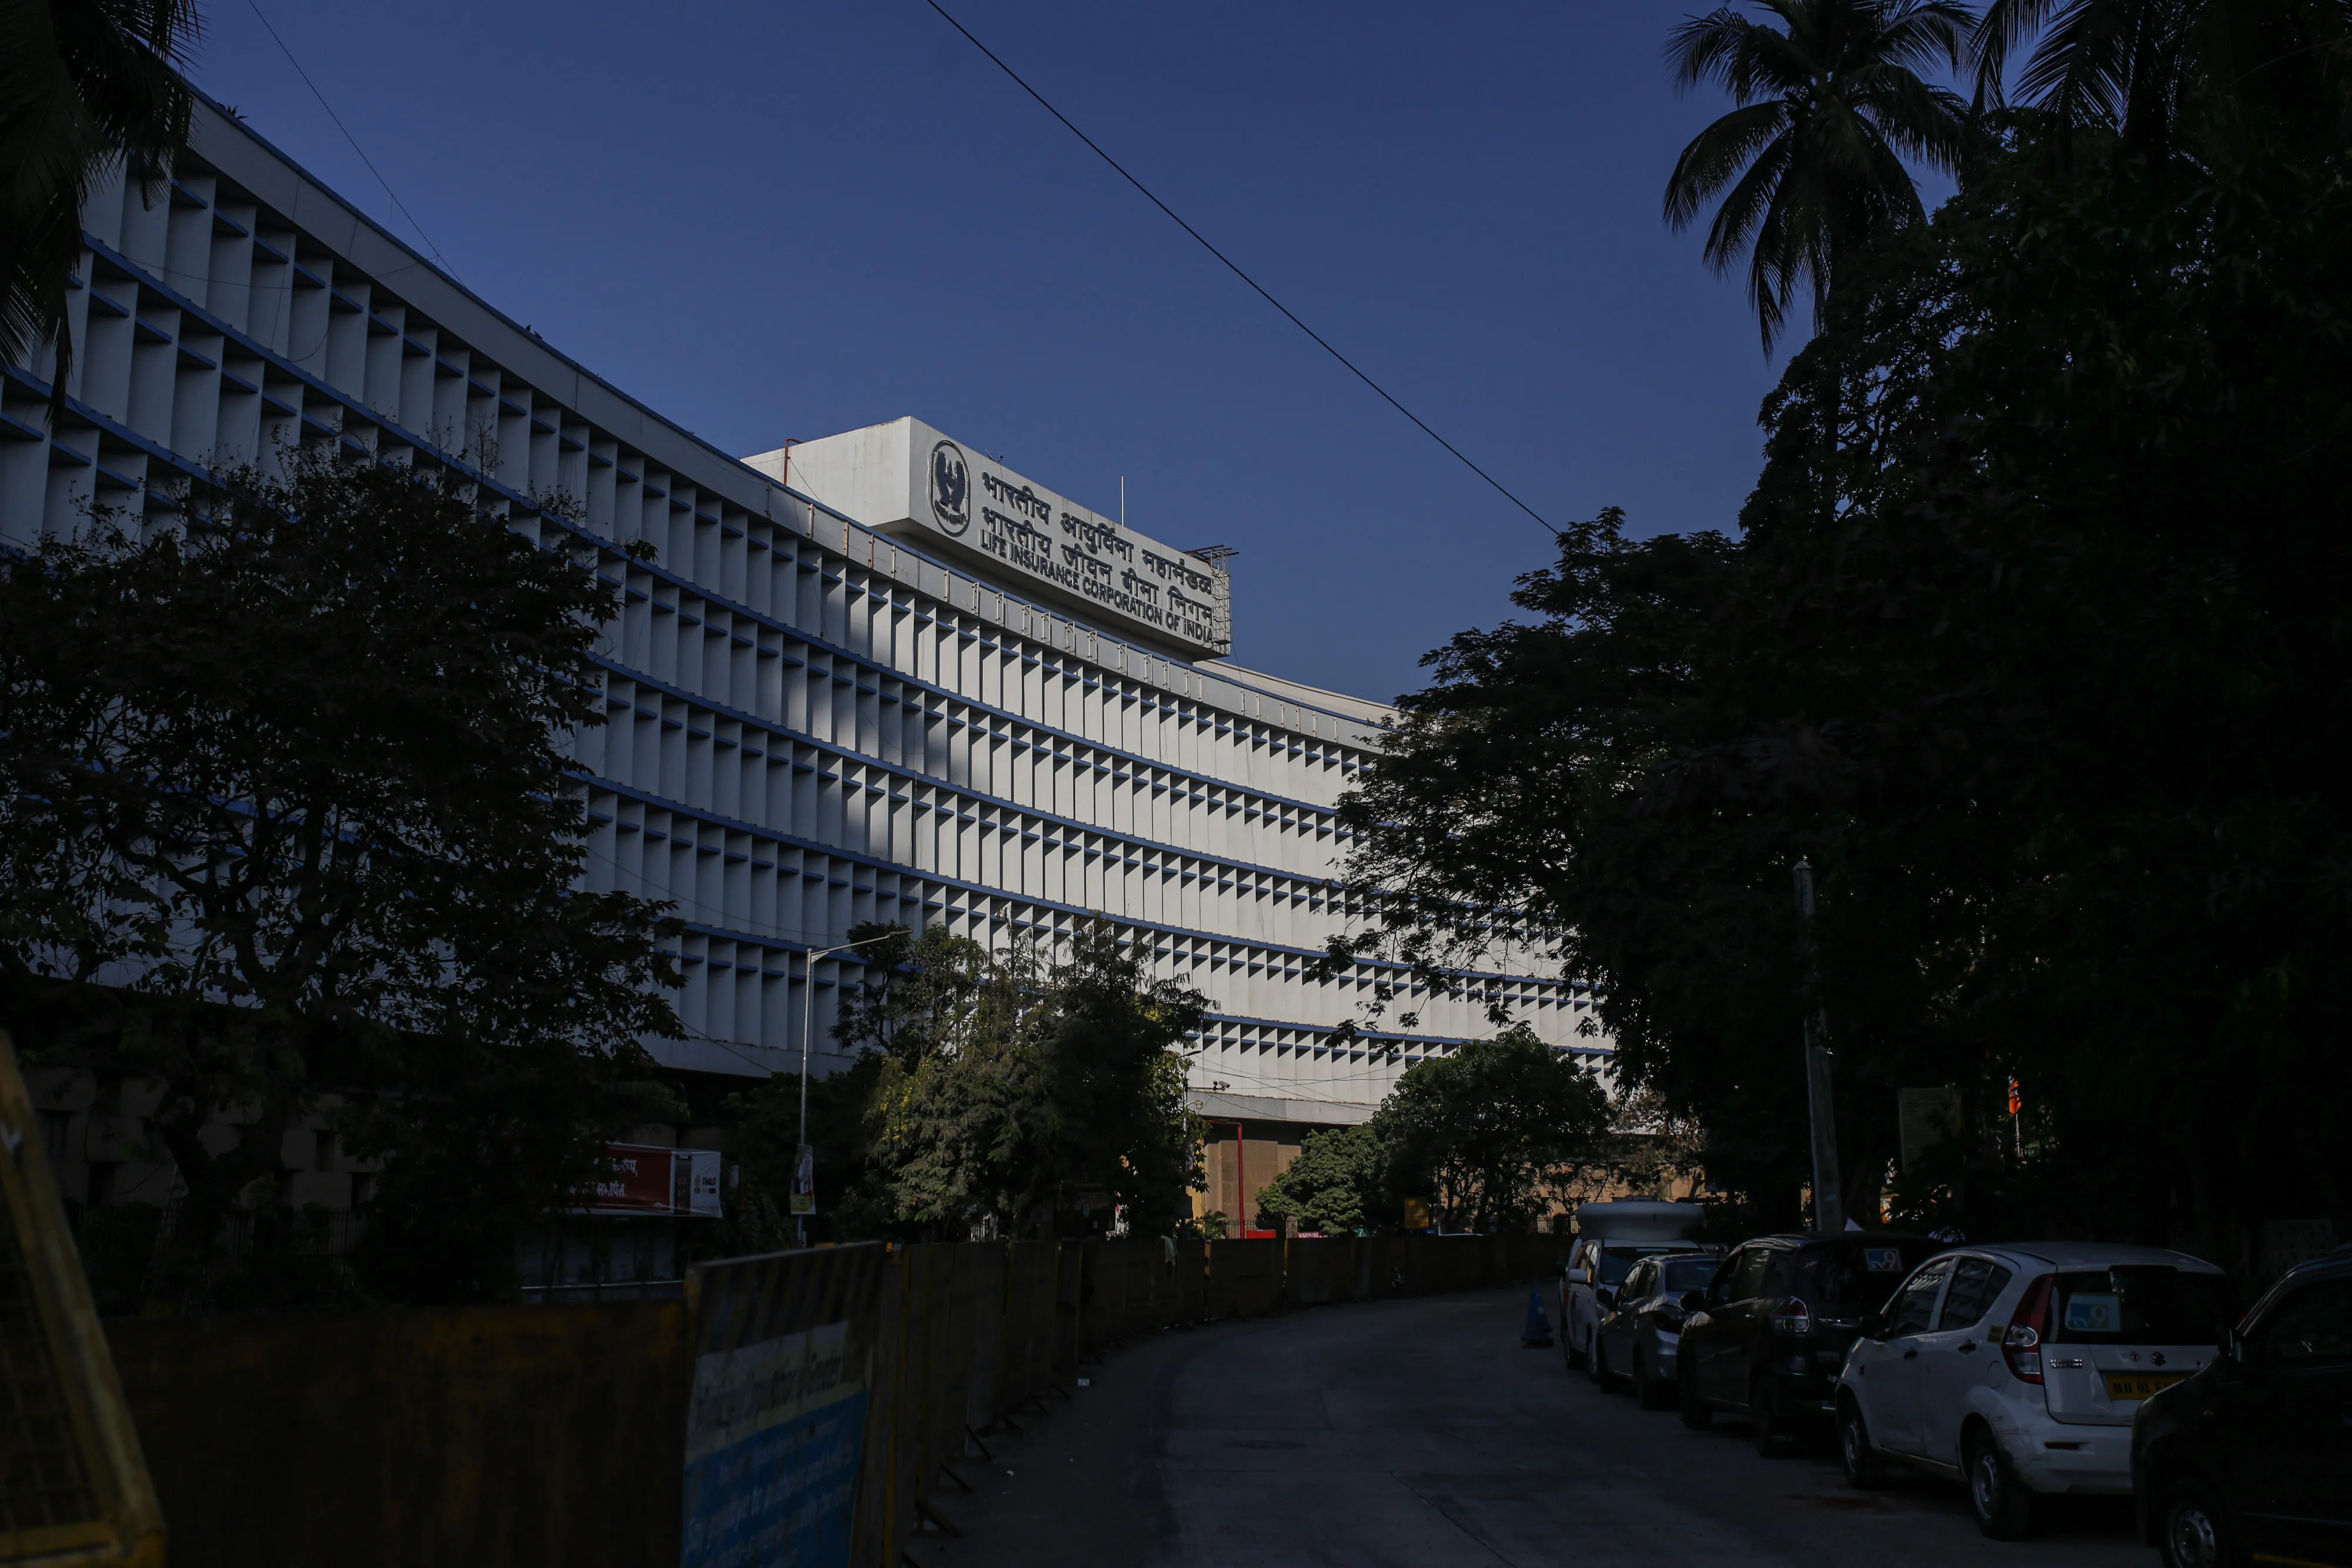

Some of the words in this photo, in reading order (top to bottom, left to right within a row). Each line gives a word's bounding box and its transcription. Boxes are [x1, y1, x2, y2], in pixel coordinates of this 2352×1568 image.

[981, 472, 1051, 525] भारतीय
[1141, 548, 1213, 595] महामंडळ
[981, 529, 1007, 559] LIFE
[1009, 543, 1080, 591] INSURANCE
[1083, 577, 1163, 626] CORPORATION
[1166, 611, 1180, 631] OF
[1182, 618, 1212, 641] INDIA
[982, 506, 1052, 559] भारतीय
[1060, 543, 1113, 586] जीवन
[1120, 567, 1160, 604] बीमा
[1167, 585, 1213, 627] निगम
